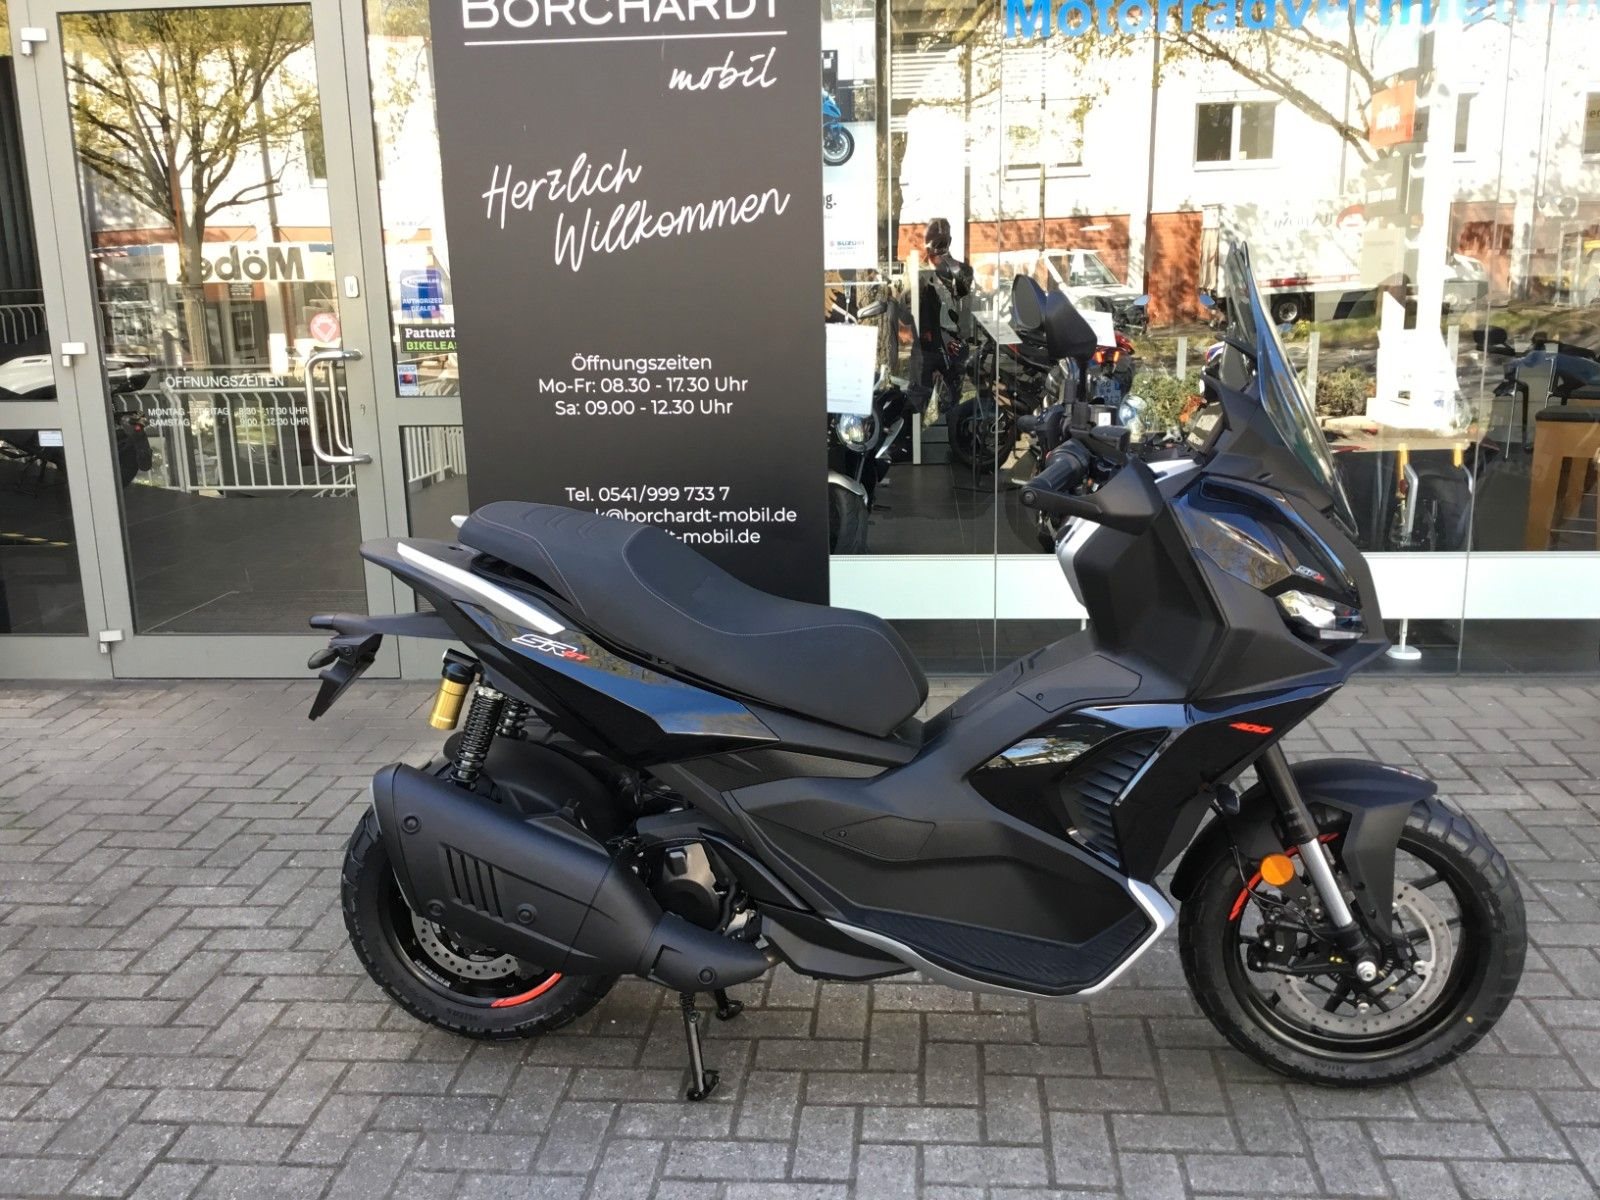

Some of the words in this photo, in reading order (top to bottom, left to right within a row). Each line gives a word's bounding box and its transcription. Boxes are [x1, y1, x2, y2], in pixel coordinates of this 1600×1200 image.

[668, 46, 777, 91] mobil
[481, 148, 642, 230] Herzlich
[554, 187, 791, 273] Willkommen
[406, 341, 457, 351] BIKELEA
[571, 353, 713, 375] Öffnungszeiten
[538, 377, 597, 394] Mo-Fr:
[600, 376, 651, 393] 08.30
[666, 376, 710, 393] 17.30
[714, 375, 749, 392] Uhr
[147, 407, 186, 416] MONTAG
[238, 407, 257, 415] 830
[265, 407, 288, 415] 1730
[288, 406, 309, 415] UHR
[554, 400, 581, 416] Sa:
[584, 399, 636, 416] 09.00
[650, 399, 695, 415] 12.30
[699, 398, 734, 415] Uhr
[149, 418, 191, 427] SAMSTAG
[266, 417, 289, 426] 1230
[289, 416, 310, 426] UHR
[564, 486, 595, 502] Tel.
[598, 484, 680, 504] 0541/999
[683, 486, 716, 501] 733
[718, 486, 731, 501] 7
[664, 528, 761, 544] -mobil.de
